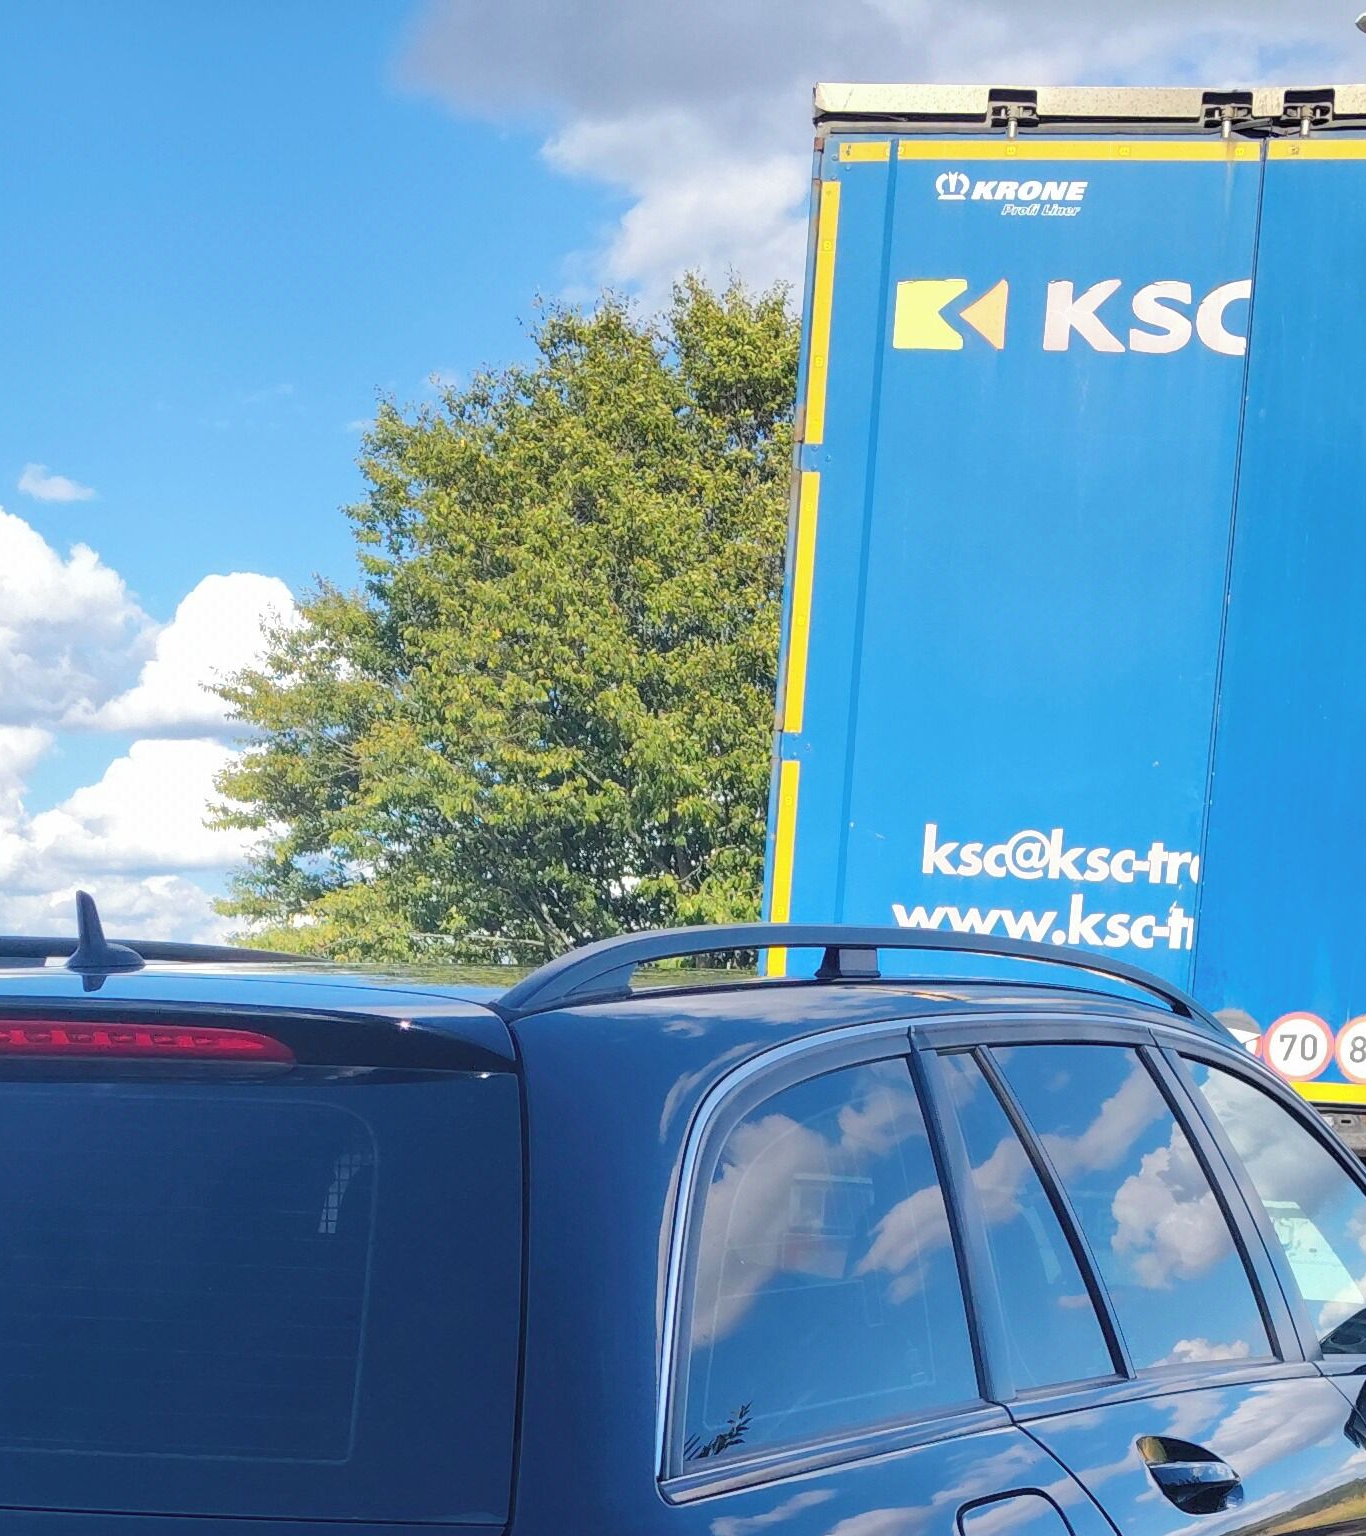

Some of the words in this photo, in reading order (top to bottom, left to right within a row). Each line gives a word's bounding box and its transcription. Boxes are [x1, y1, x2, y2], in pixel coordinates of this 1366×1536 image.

[970, 180, 1089, 201] KRONE
[1001, 203, 1040, 216] Profi
[1043, 279, 1252, 356] KSC
[1279, 1033, 1318, 1061] 70
